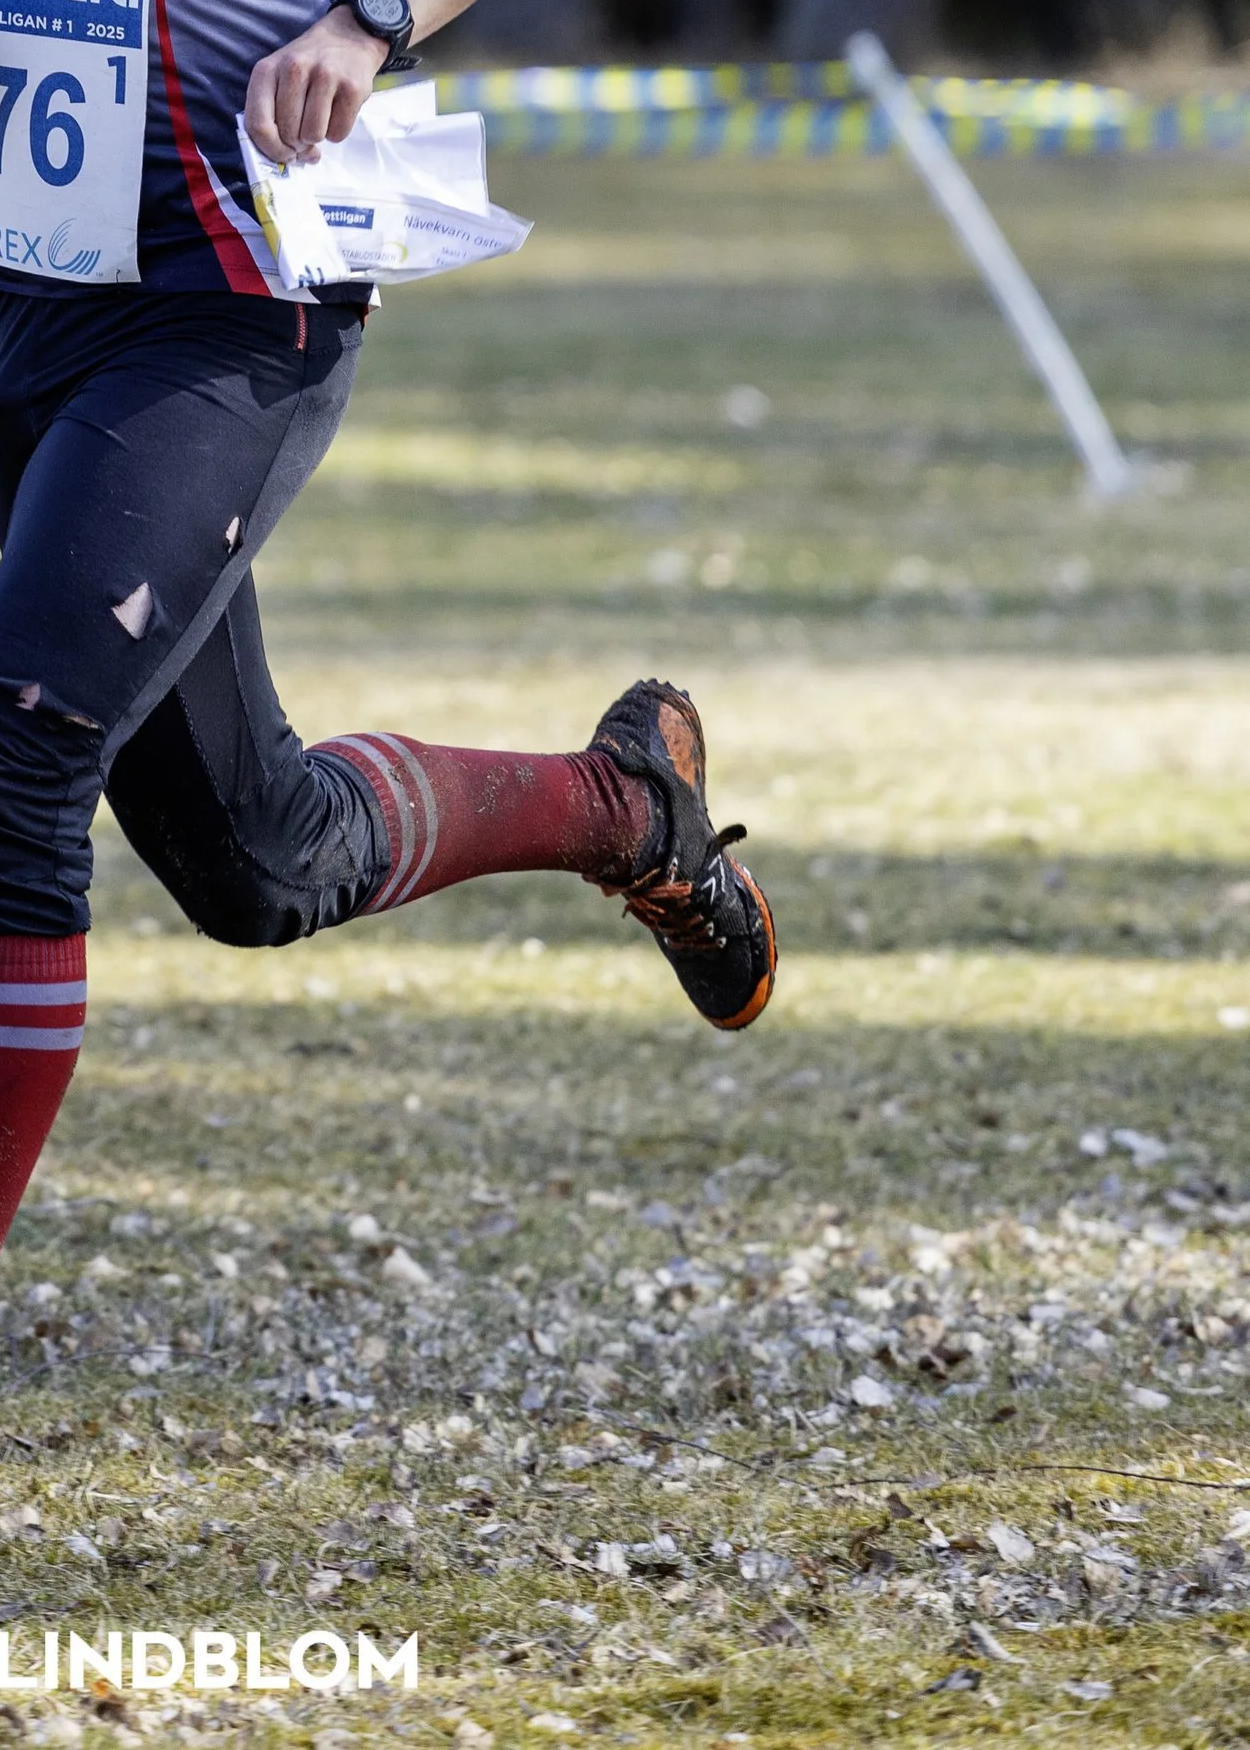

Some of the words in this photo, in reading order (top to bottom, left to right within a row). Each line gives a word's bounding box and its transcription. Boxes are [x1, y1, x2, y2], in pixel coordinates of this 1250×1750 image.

[86, 22, 125, 40] 2025
[107, 56, 127, 105] 1
[403, 214, 470, 241] Nävekvarn
